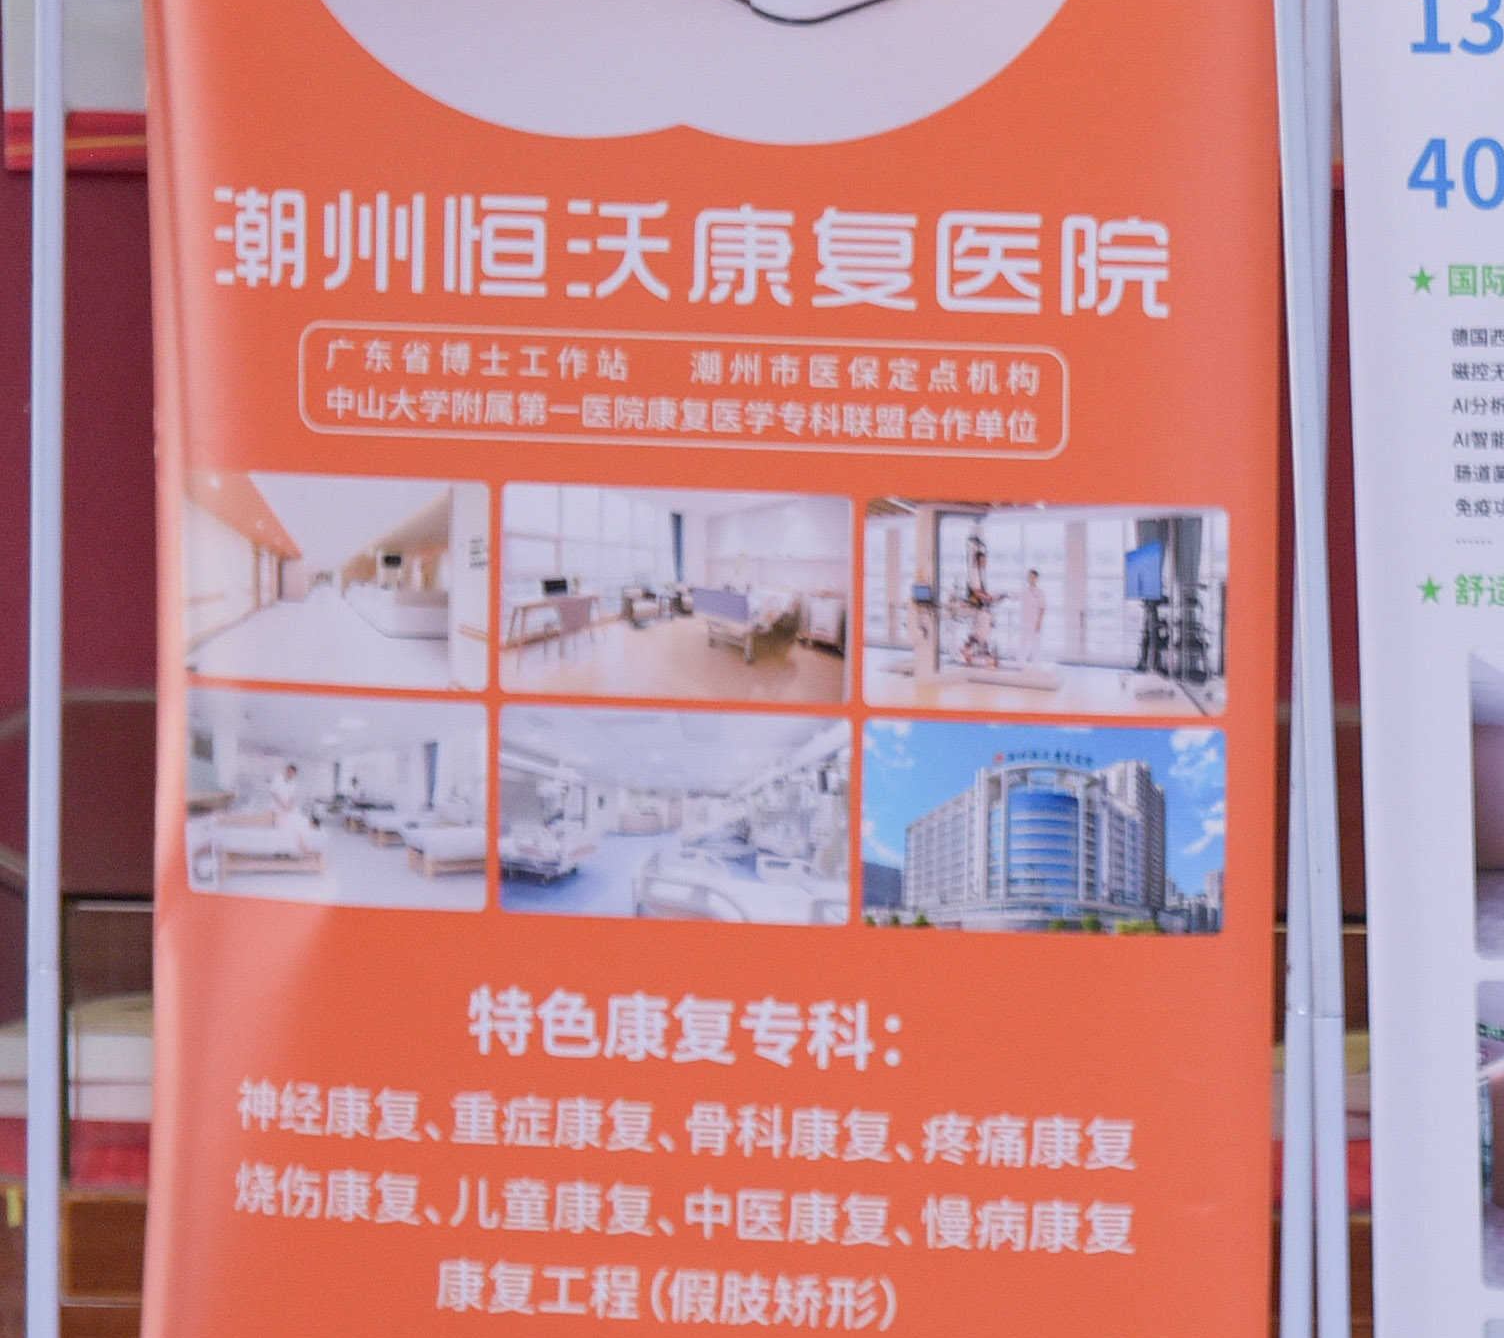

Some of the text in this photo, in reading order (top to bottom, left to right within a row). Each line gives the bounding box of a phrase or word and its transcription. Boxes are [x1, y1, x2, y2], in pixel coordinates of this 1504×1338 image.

[213, 186, 1172, 319] 潮州恒沃康复医院
[325, 336, 1041, 397] 广东省博士工作站 潮州市医保定点机构
[324, 386, 1040, 446] 中山大学附属第一医院康复医学专科联盟合作单位
[467, 986, 904, 1070] 特色康复专科：
[236, 1077, 1138, 1173] 神经康复、重症康复、骨科康复、疼痛康复
[233, 1162, 1137, 1257] 烧伤康复、儿童康复、中医康复、慢病康复
